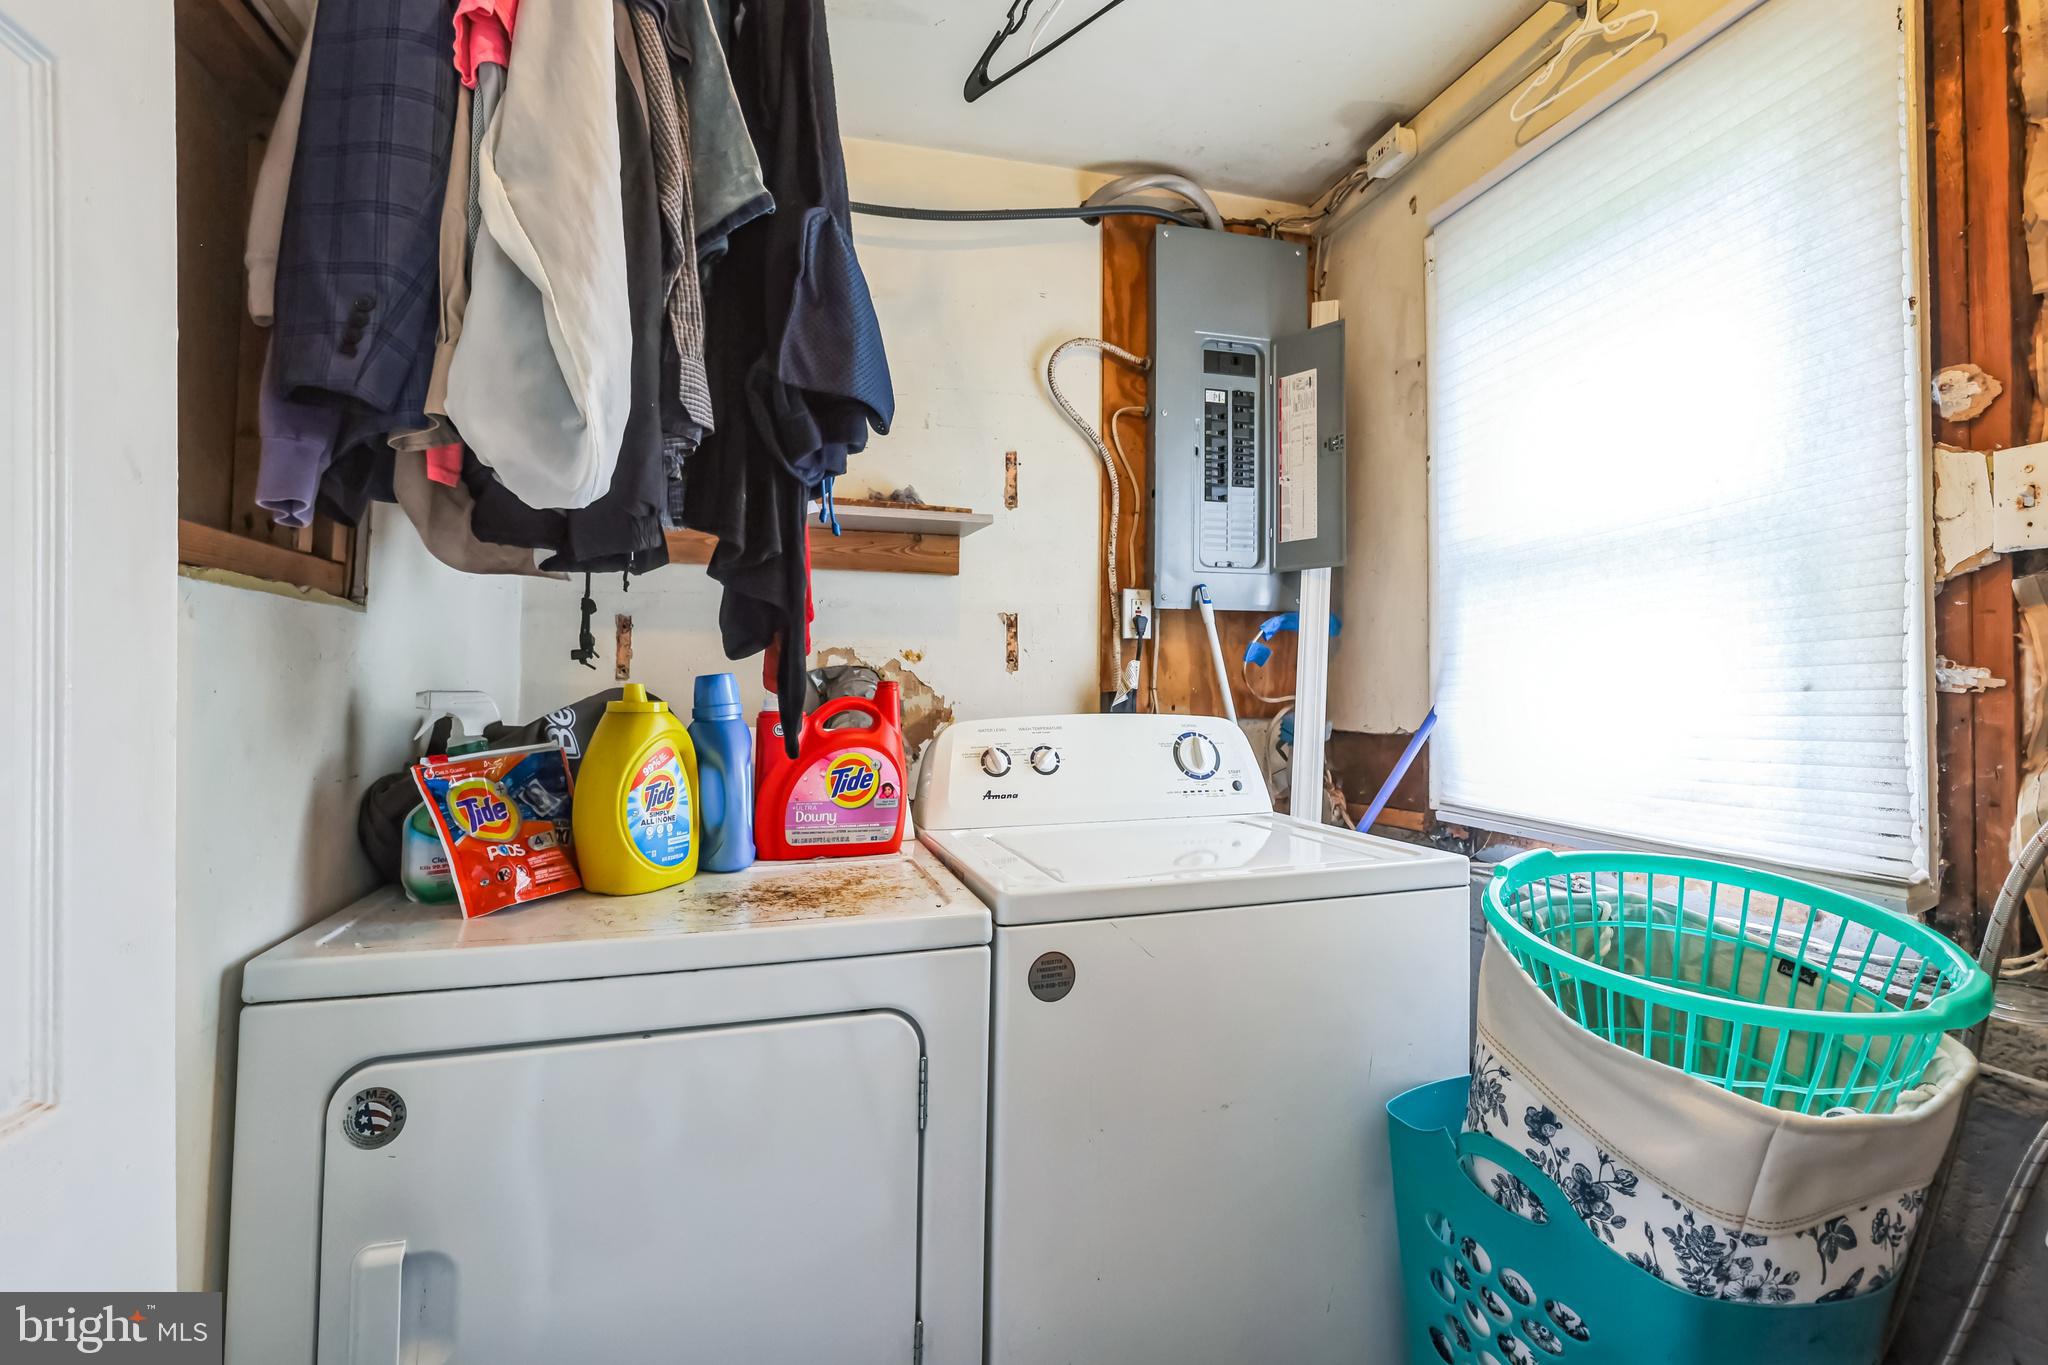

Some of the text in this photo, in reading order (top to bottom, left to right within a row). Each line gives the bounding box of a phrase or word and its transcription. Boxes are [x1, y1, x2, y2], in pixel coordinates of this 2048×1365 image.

[830, 766, 874, 800] Tide
[645, 781, 675, 813] Tide
[983, 790, 1019, 801] Amana
[455, 796, 509, 834] Tide
[649, 810, 669, 818] SIMPLY
[663, 814, 676, 823] ONE
[795, 810, 837, 826] Downy
[486, 844, 526, 861] PODS
